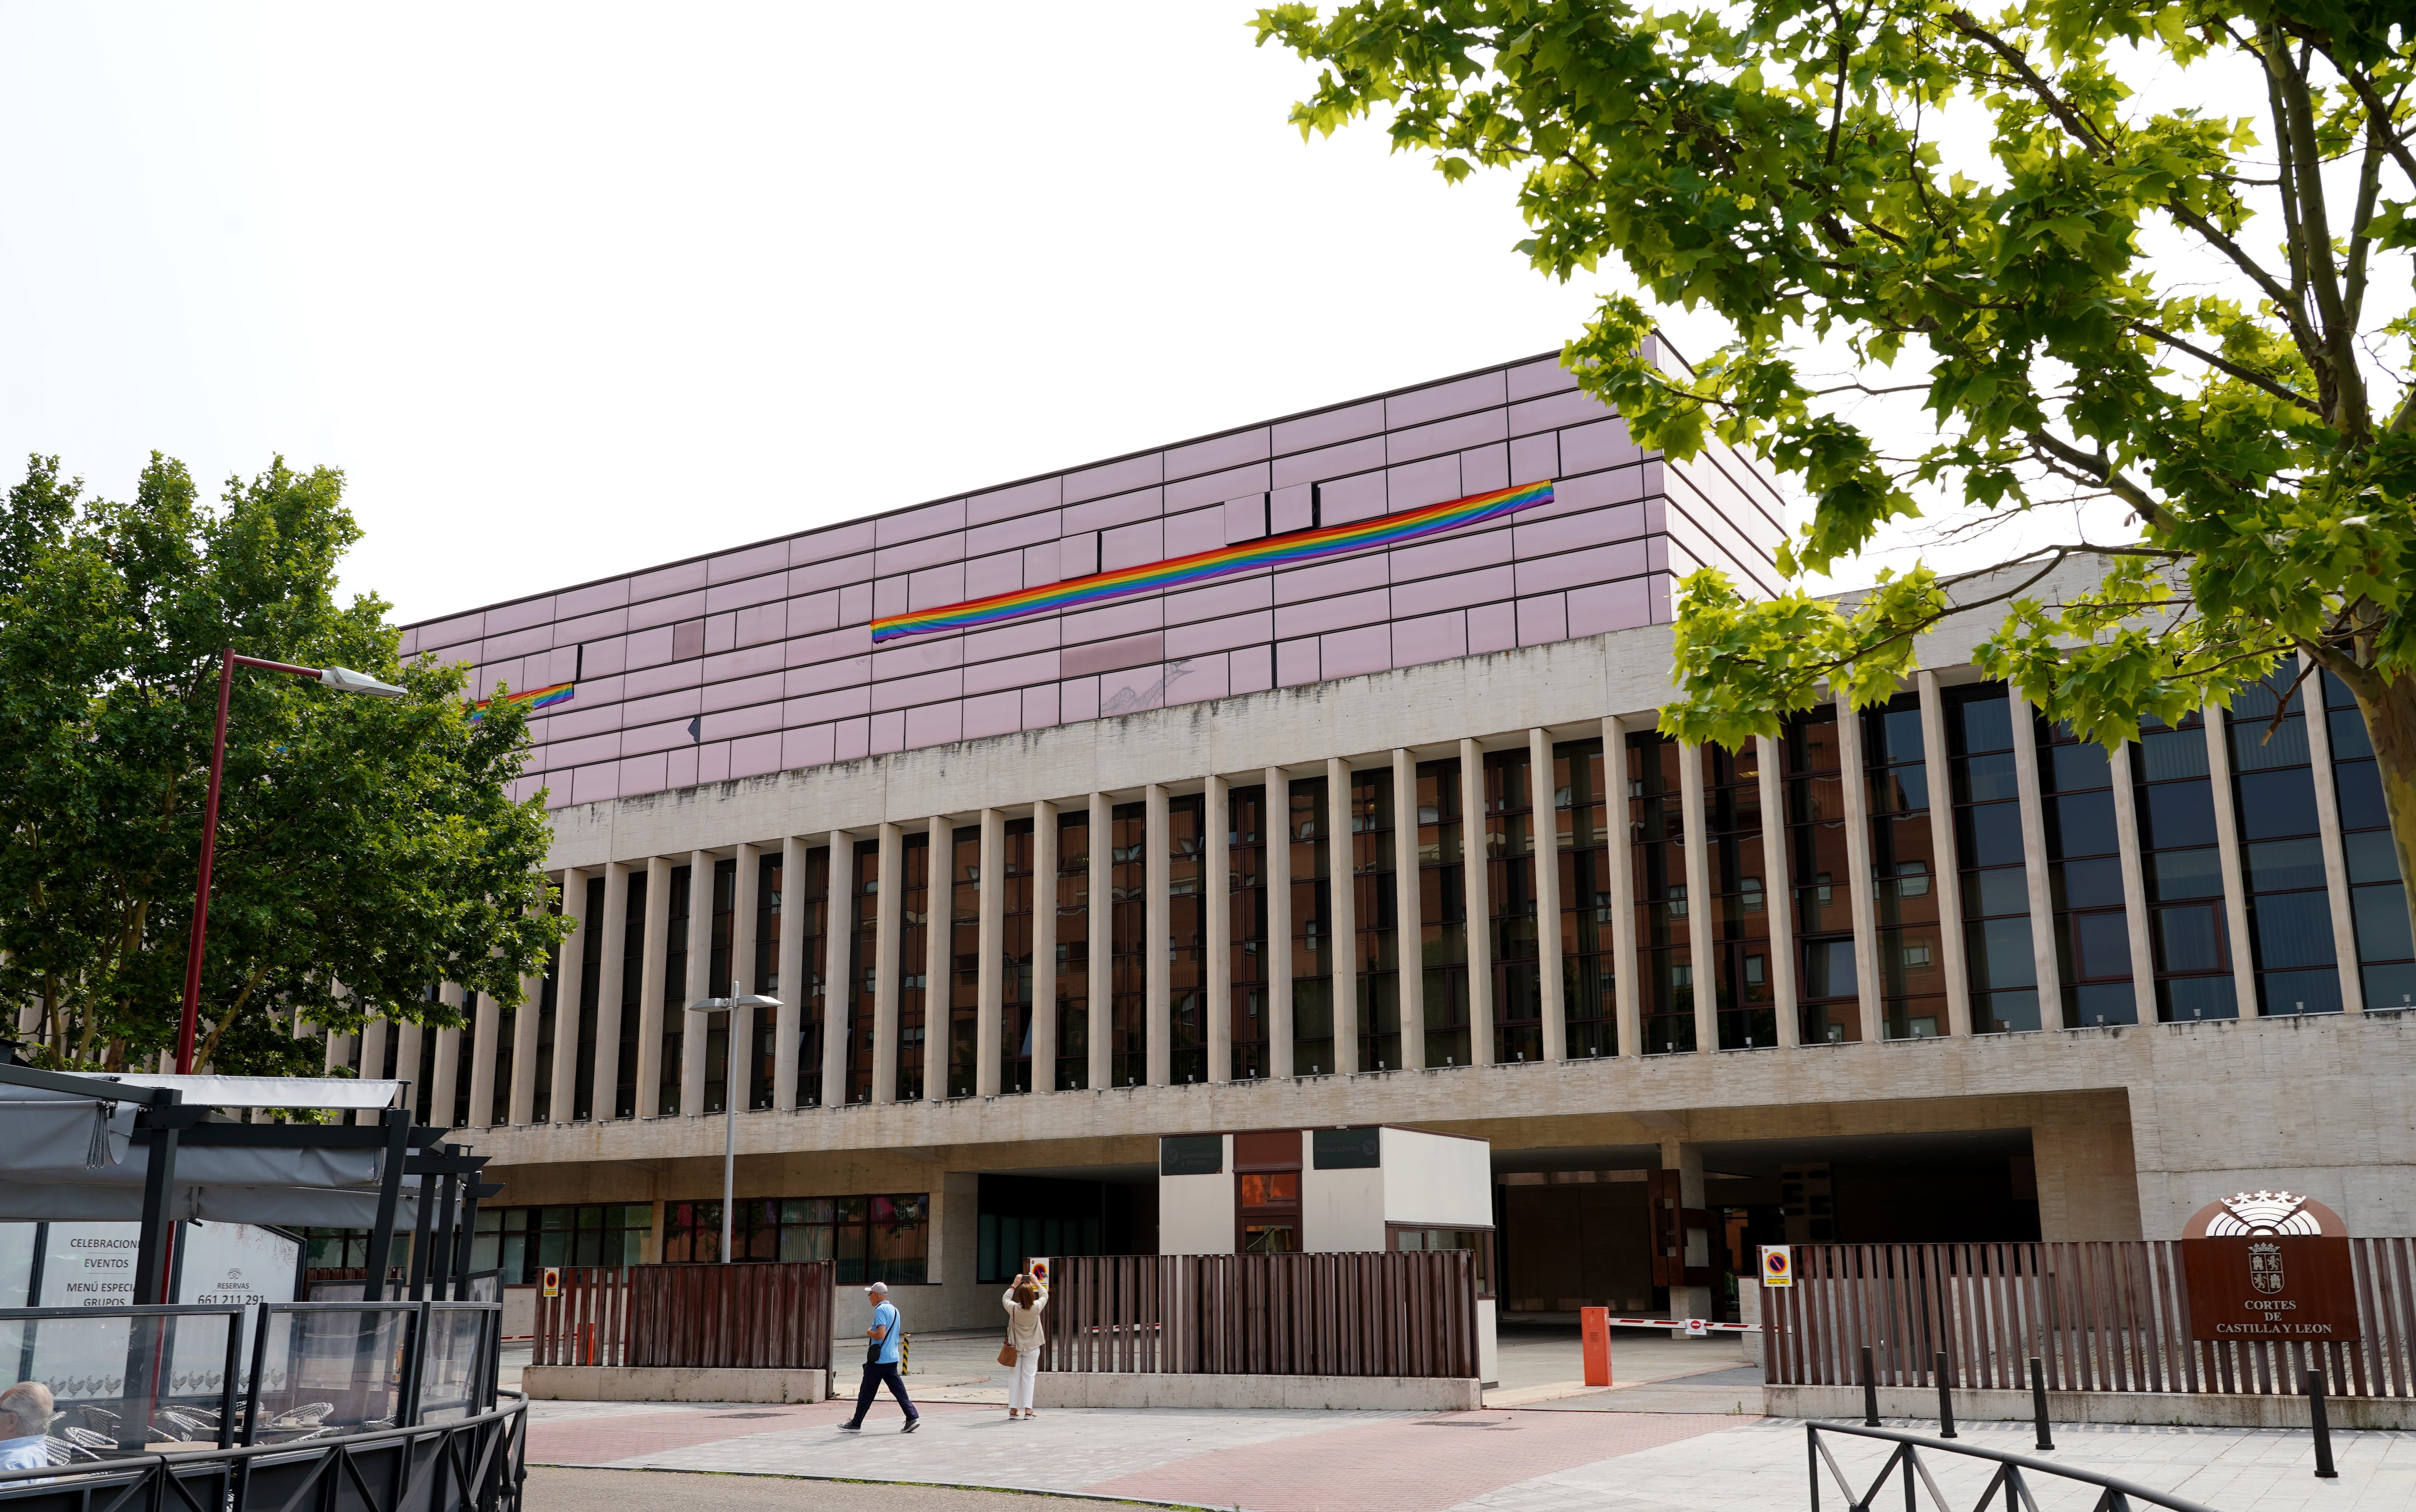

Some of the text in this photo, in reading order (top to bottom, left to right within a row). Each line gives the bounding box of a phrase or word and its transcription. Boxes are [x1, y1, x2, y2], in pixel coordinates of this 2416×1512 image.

[85, 1259, 129, 1268] EVENTOS
[67, 1281, 98, 1292] MENÚ
[84, 1298, 125, 1306] GRUPOS
[198, 1295, 264, 1305] 661 211 291
[2244, 1300, 2297, 1310] CORTES
[2263, 1312, 2282, 1322] DE
[2216, 1323, 2332, 1334] CASTILLA Y LEON
